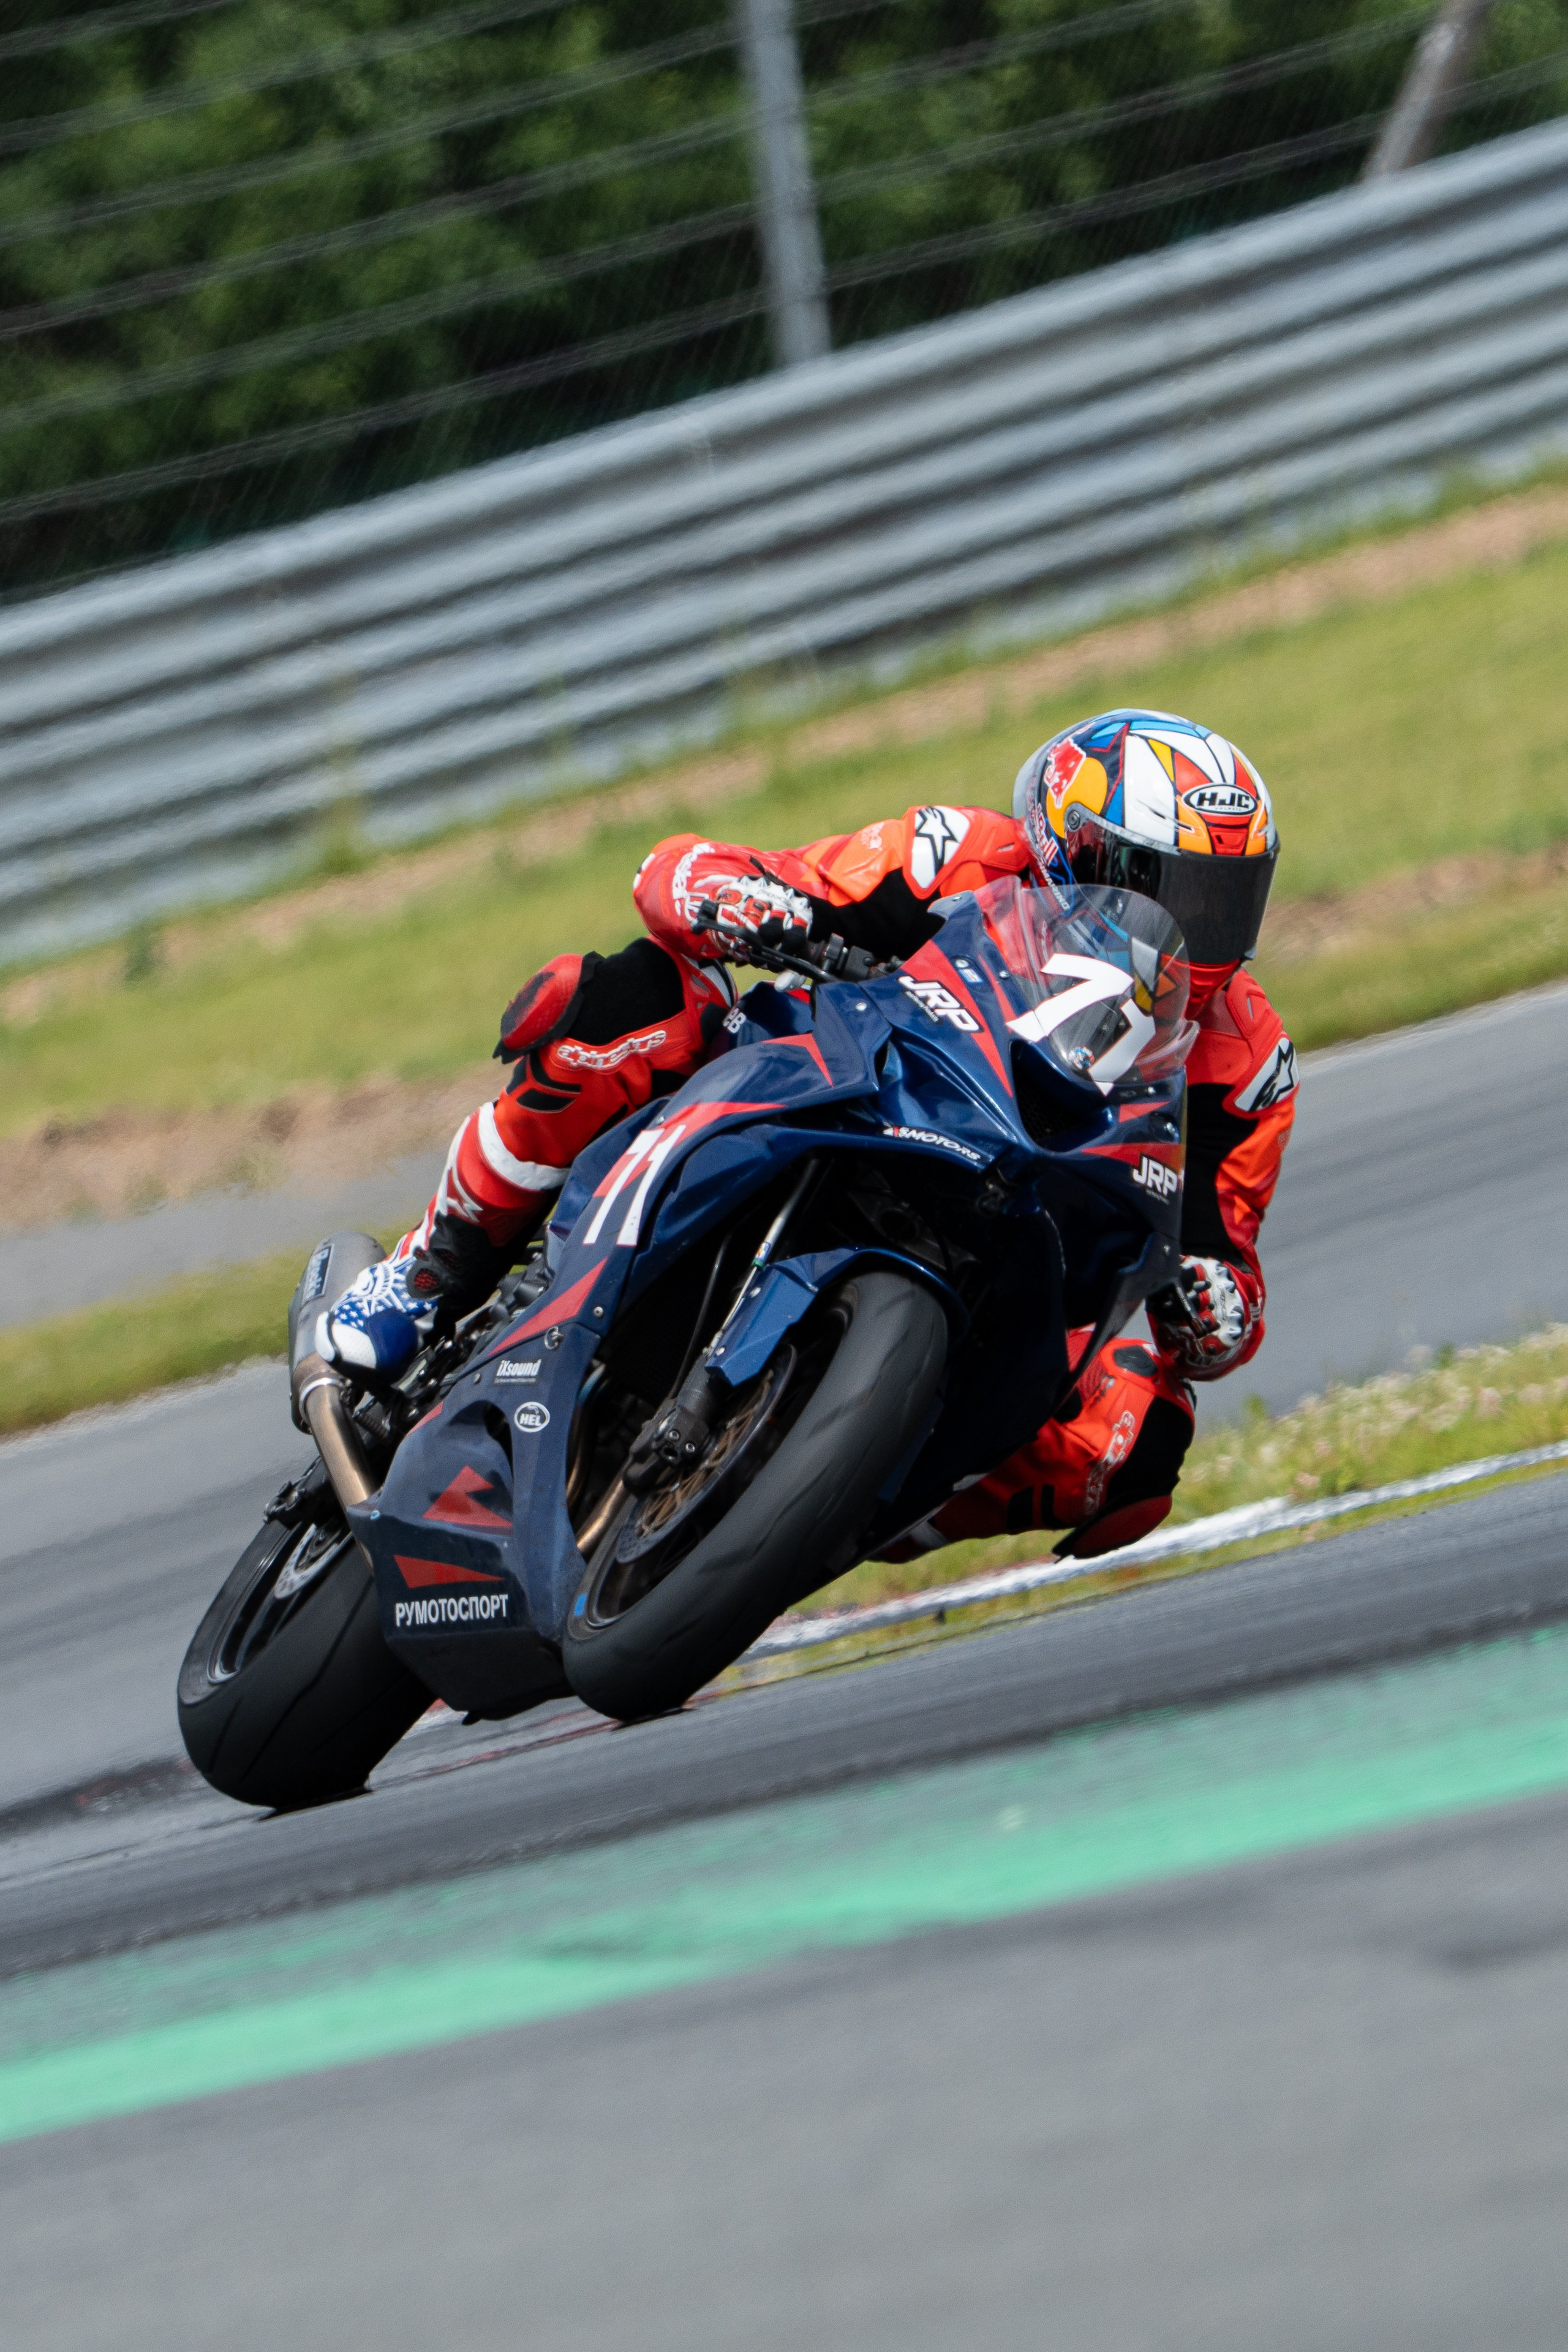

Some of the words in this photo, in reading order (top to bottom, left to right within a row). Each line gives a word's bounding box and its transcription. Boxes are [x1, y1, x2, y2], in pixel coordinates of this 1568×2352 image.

[1197, 792, 1250, 809] HJC
[898, 976, 980, 1031] JRP
[1133, 1156, 1177, 1196] JRP
[519, 1412, 542, 1427] HEL
[396, 1594, 508, 1627] РУМОТОСПОРТ
